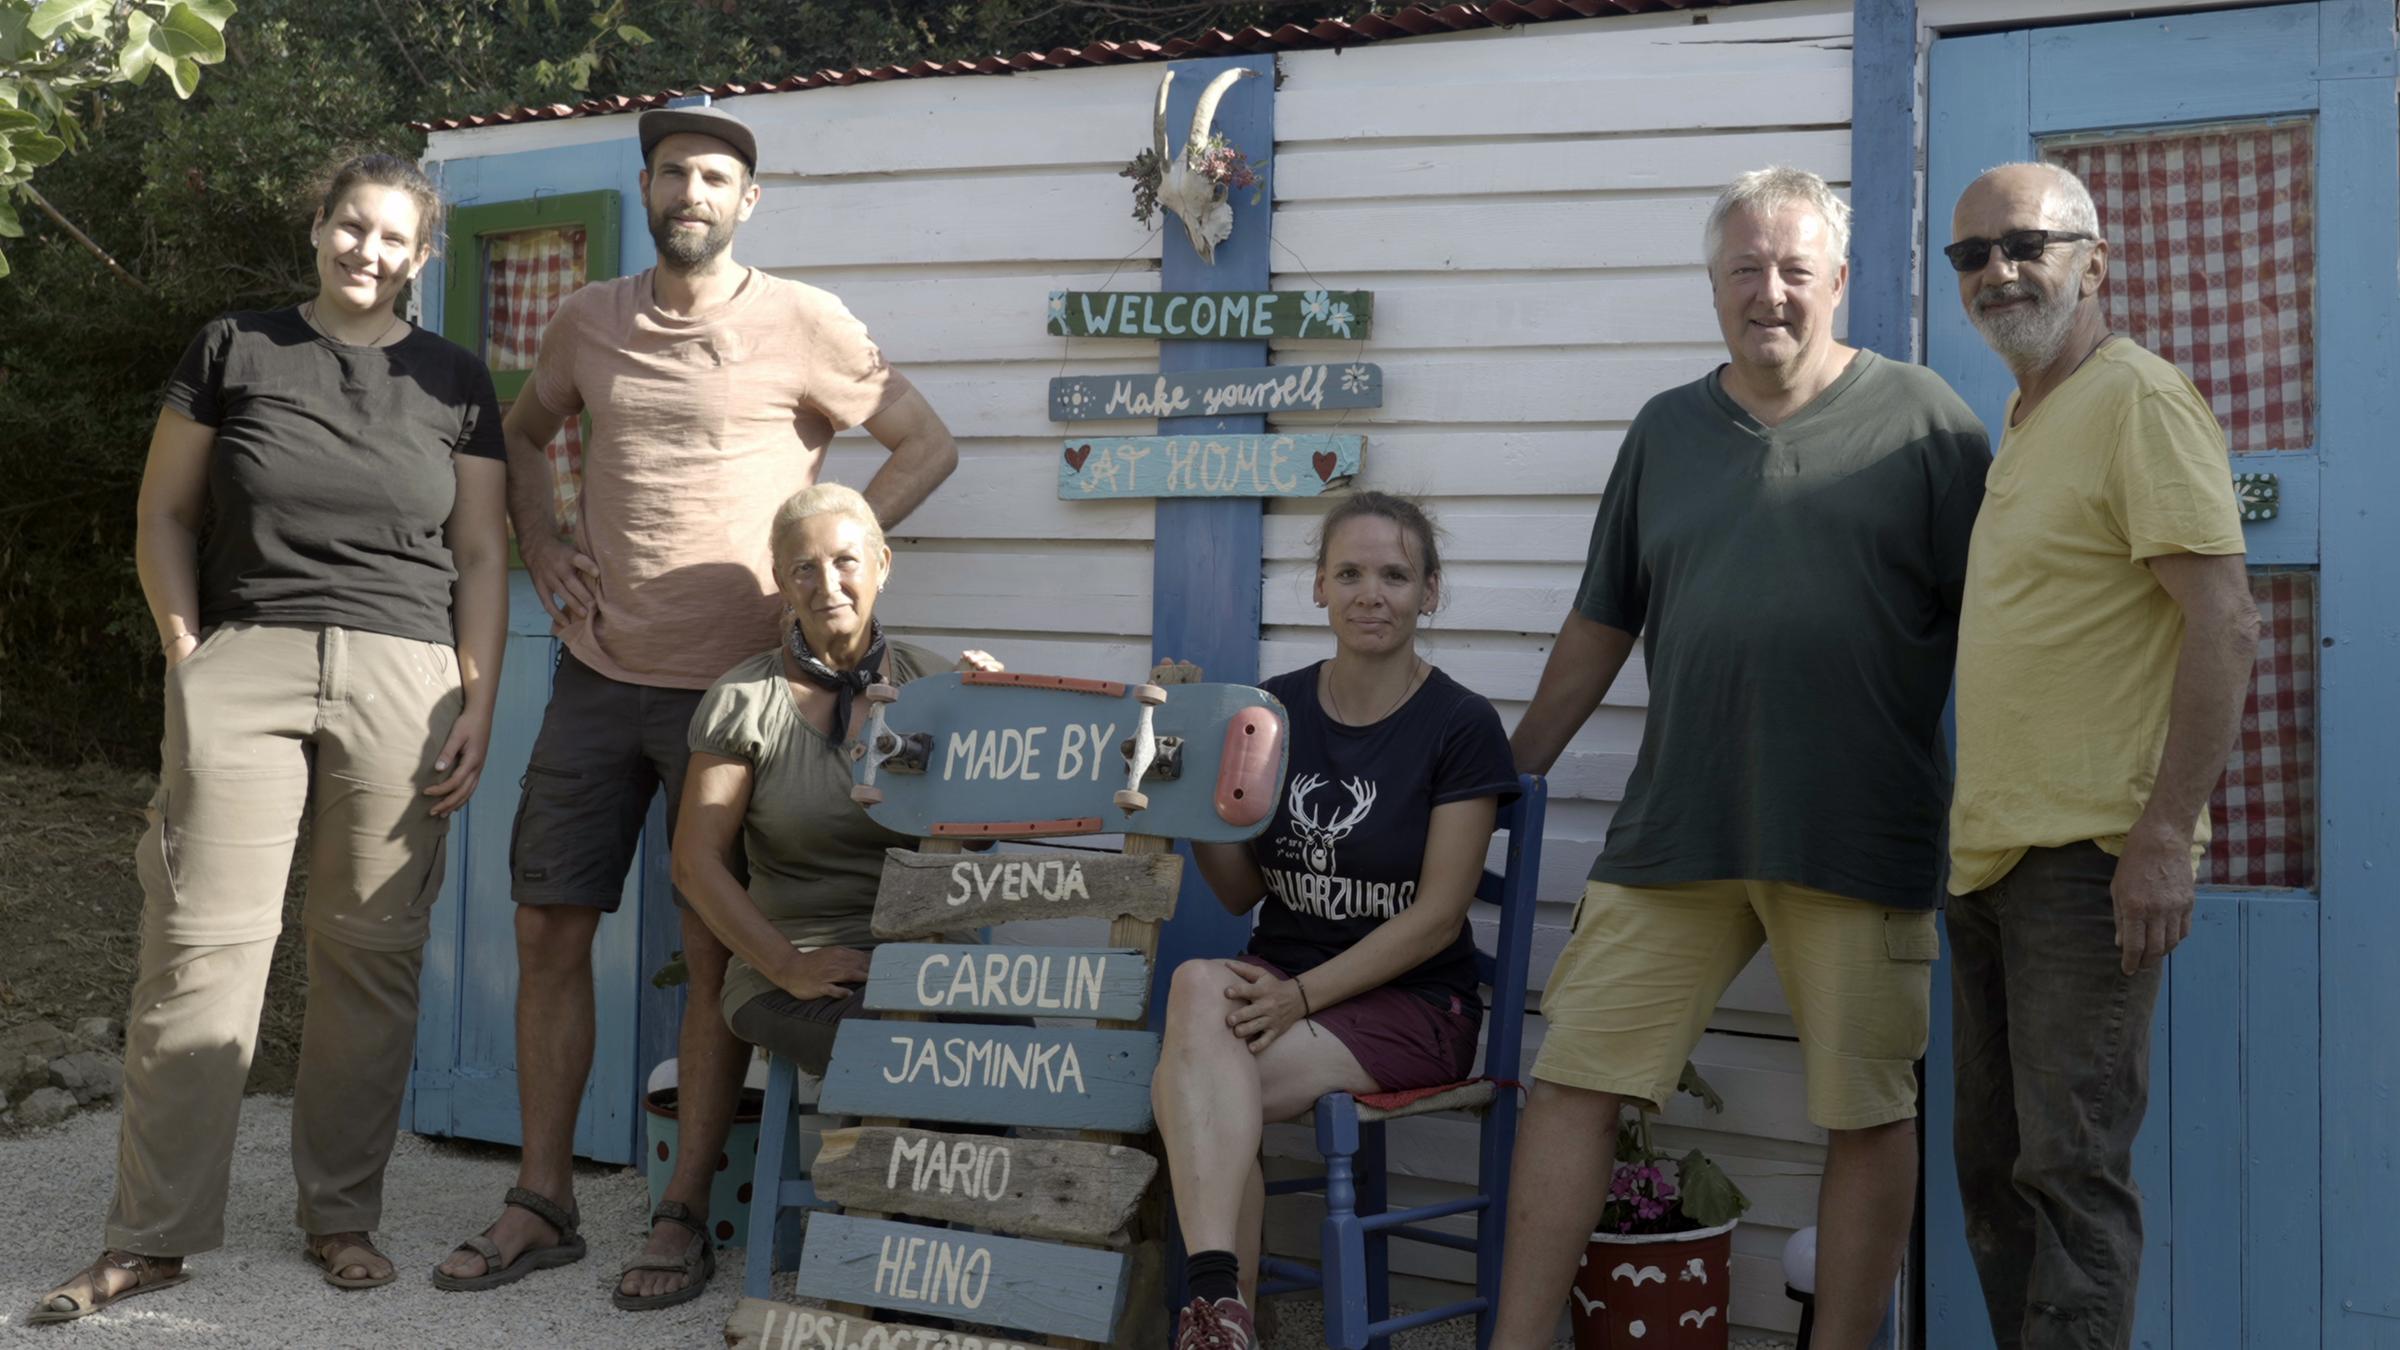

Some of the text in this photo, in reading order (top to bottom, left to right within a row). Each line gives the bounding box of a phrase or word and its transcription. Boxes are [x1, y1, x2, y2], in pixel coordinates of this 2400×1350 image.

[1081, 293, 1279, 336] WELCOME
[1105, 365, 1328, 417] Make yourself
[1080, 437, 1297, 493] AT HOME
[943, 723, 1116, 781] MADE BY
[946, 860, 1090, 906] SVENJA
[1261, 865, 1416, 921] HWARZWALD
[917, 953, 1106, 1011] CAROLIN
[883, 1037, 1086, 1093] JASMINKA
[886, 1135, 1012, 1201] MARIO
[875, 1235, 992, 1309] HEINO
